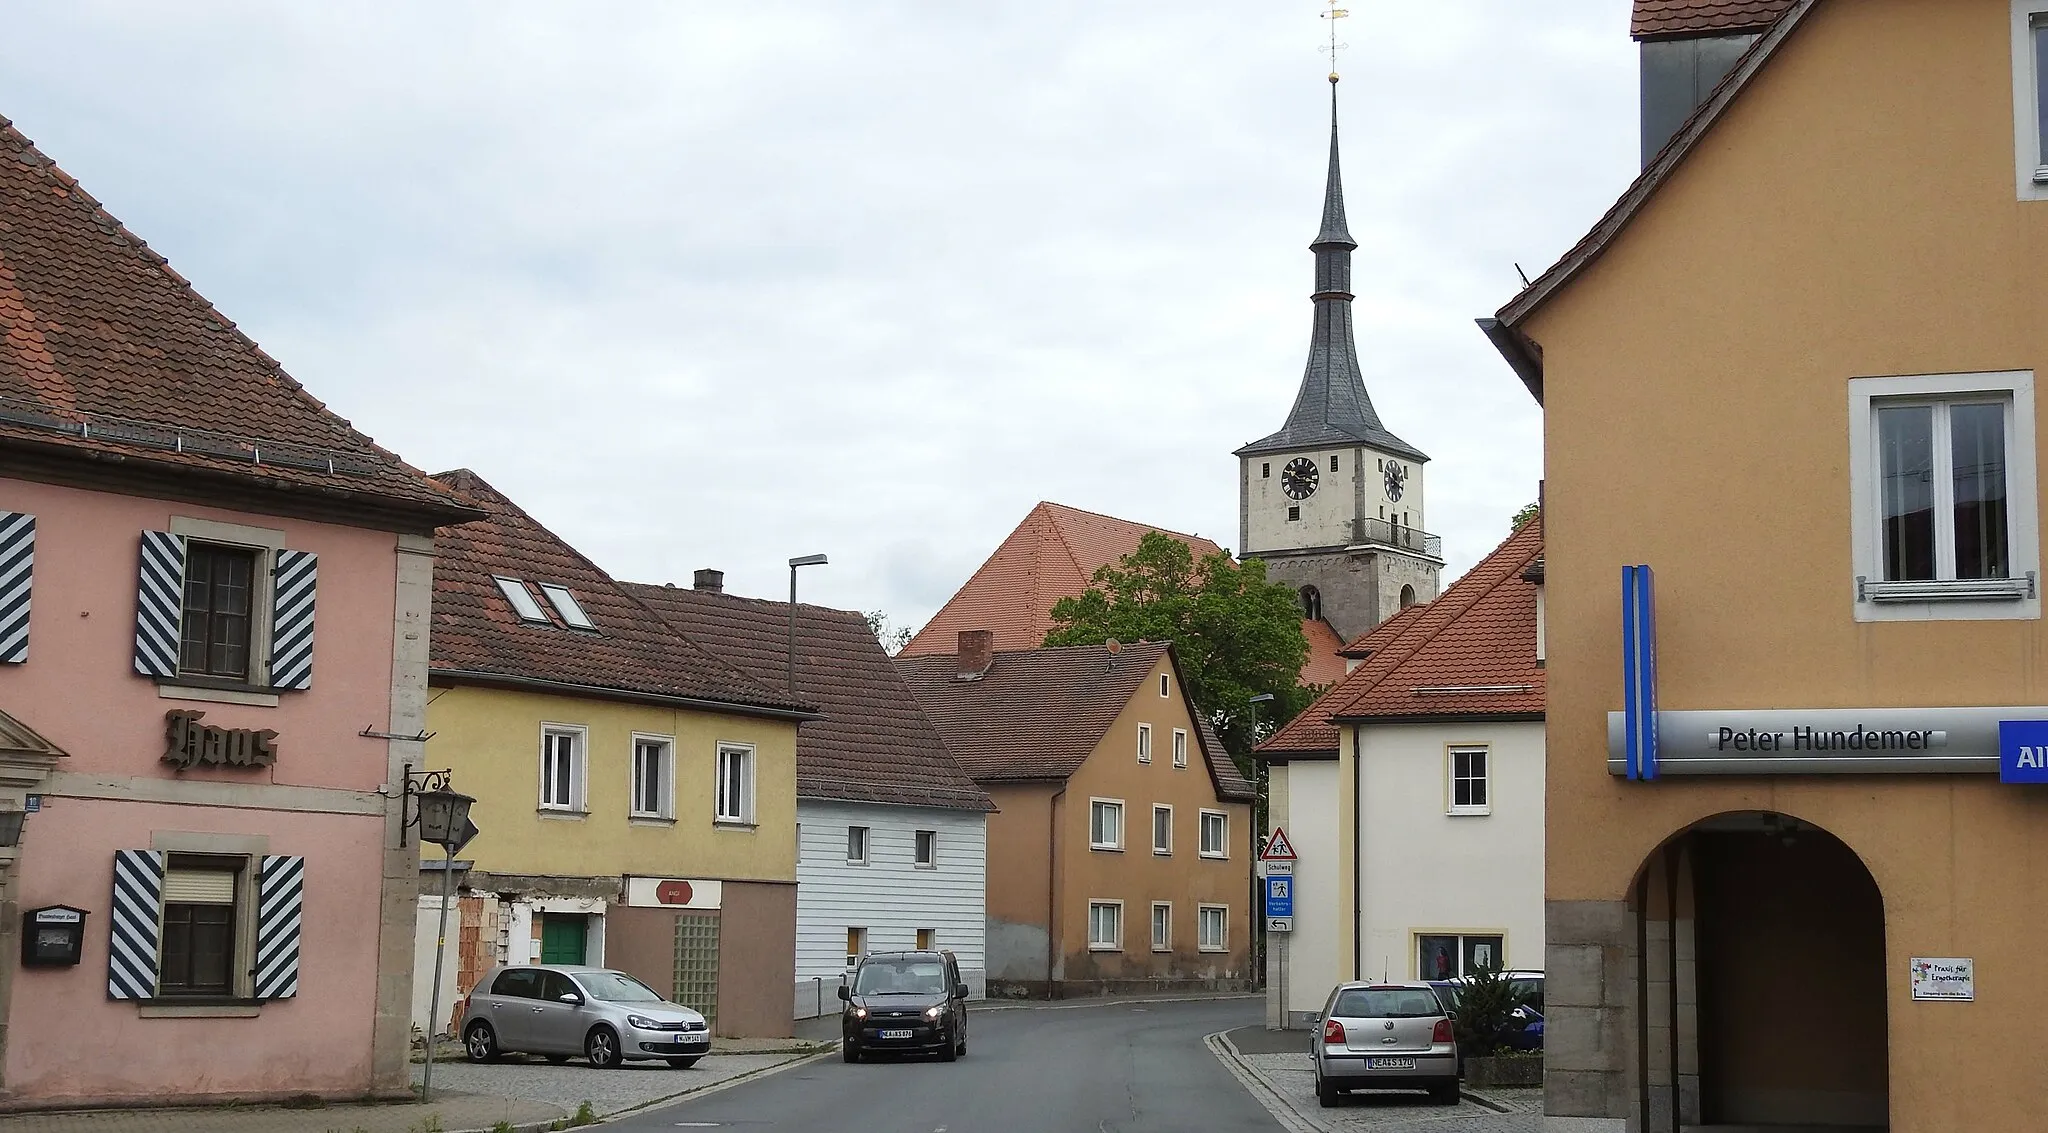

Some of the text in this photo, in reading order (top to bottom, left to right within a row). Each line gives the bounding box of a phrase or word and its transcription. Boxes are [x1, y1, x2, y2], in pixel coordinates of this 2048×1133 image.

[160, 709, 279, 771] Haus
[1718, 724, 1932, 750] Peter Hundemer
[1268, 864, 1291, 872] Schulweg
[1934, 965, 1967, 974] Praxis für
[1931, 974, 1970, 982] Ergotherapie
[1372, 1058, 1388, 1066] NEA
[1398, 1058, 1413, 1066] 170
